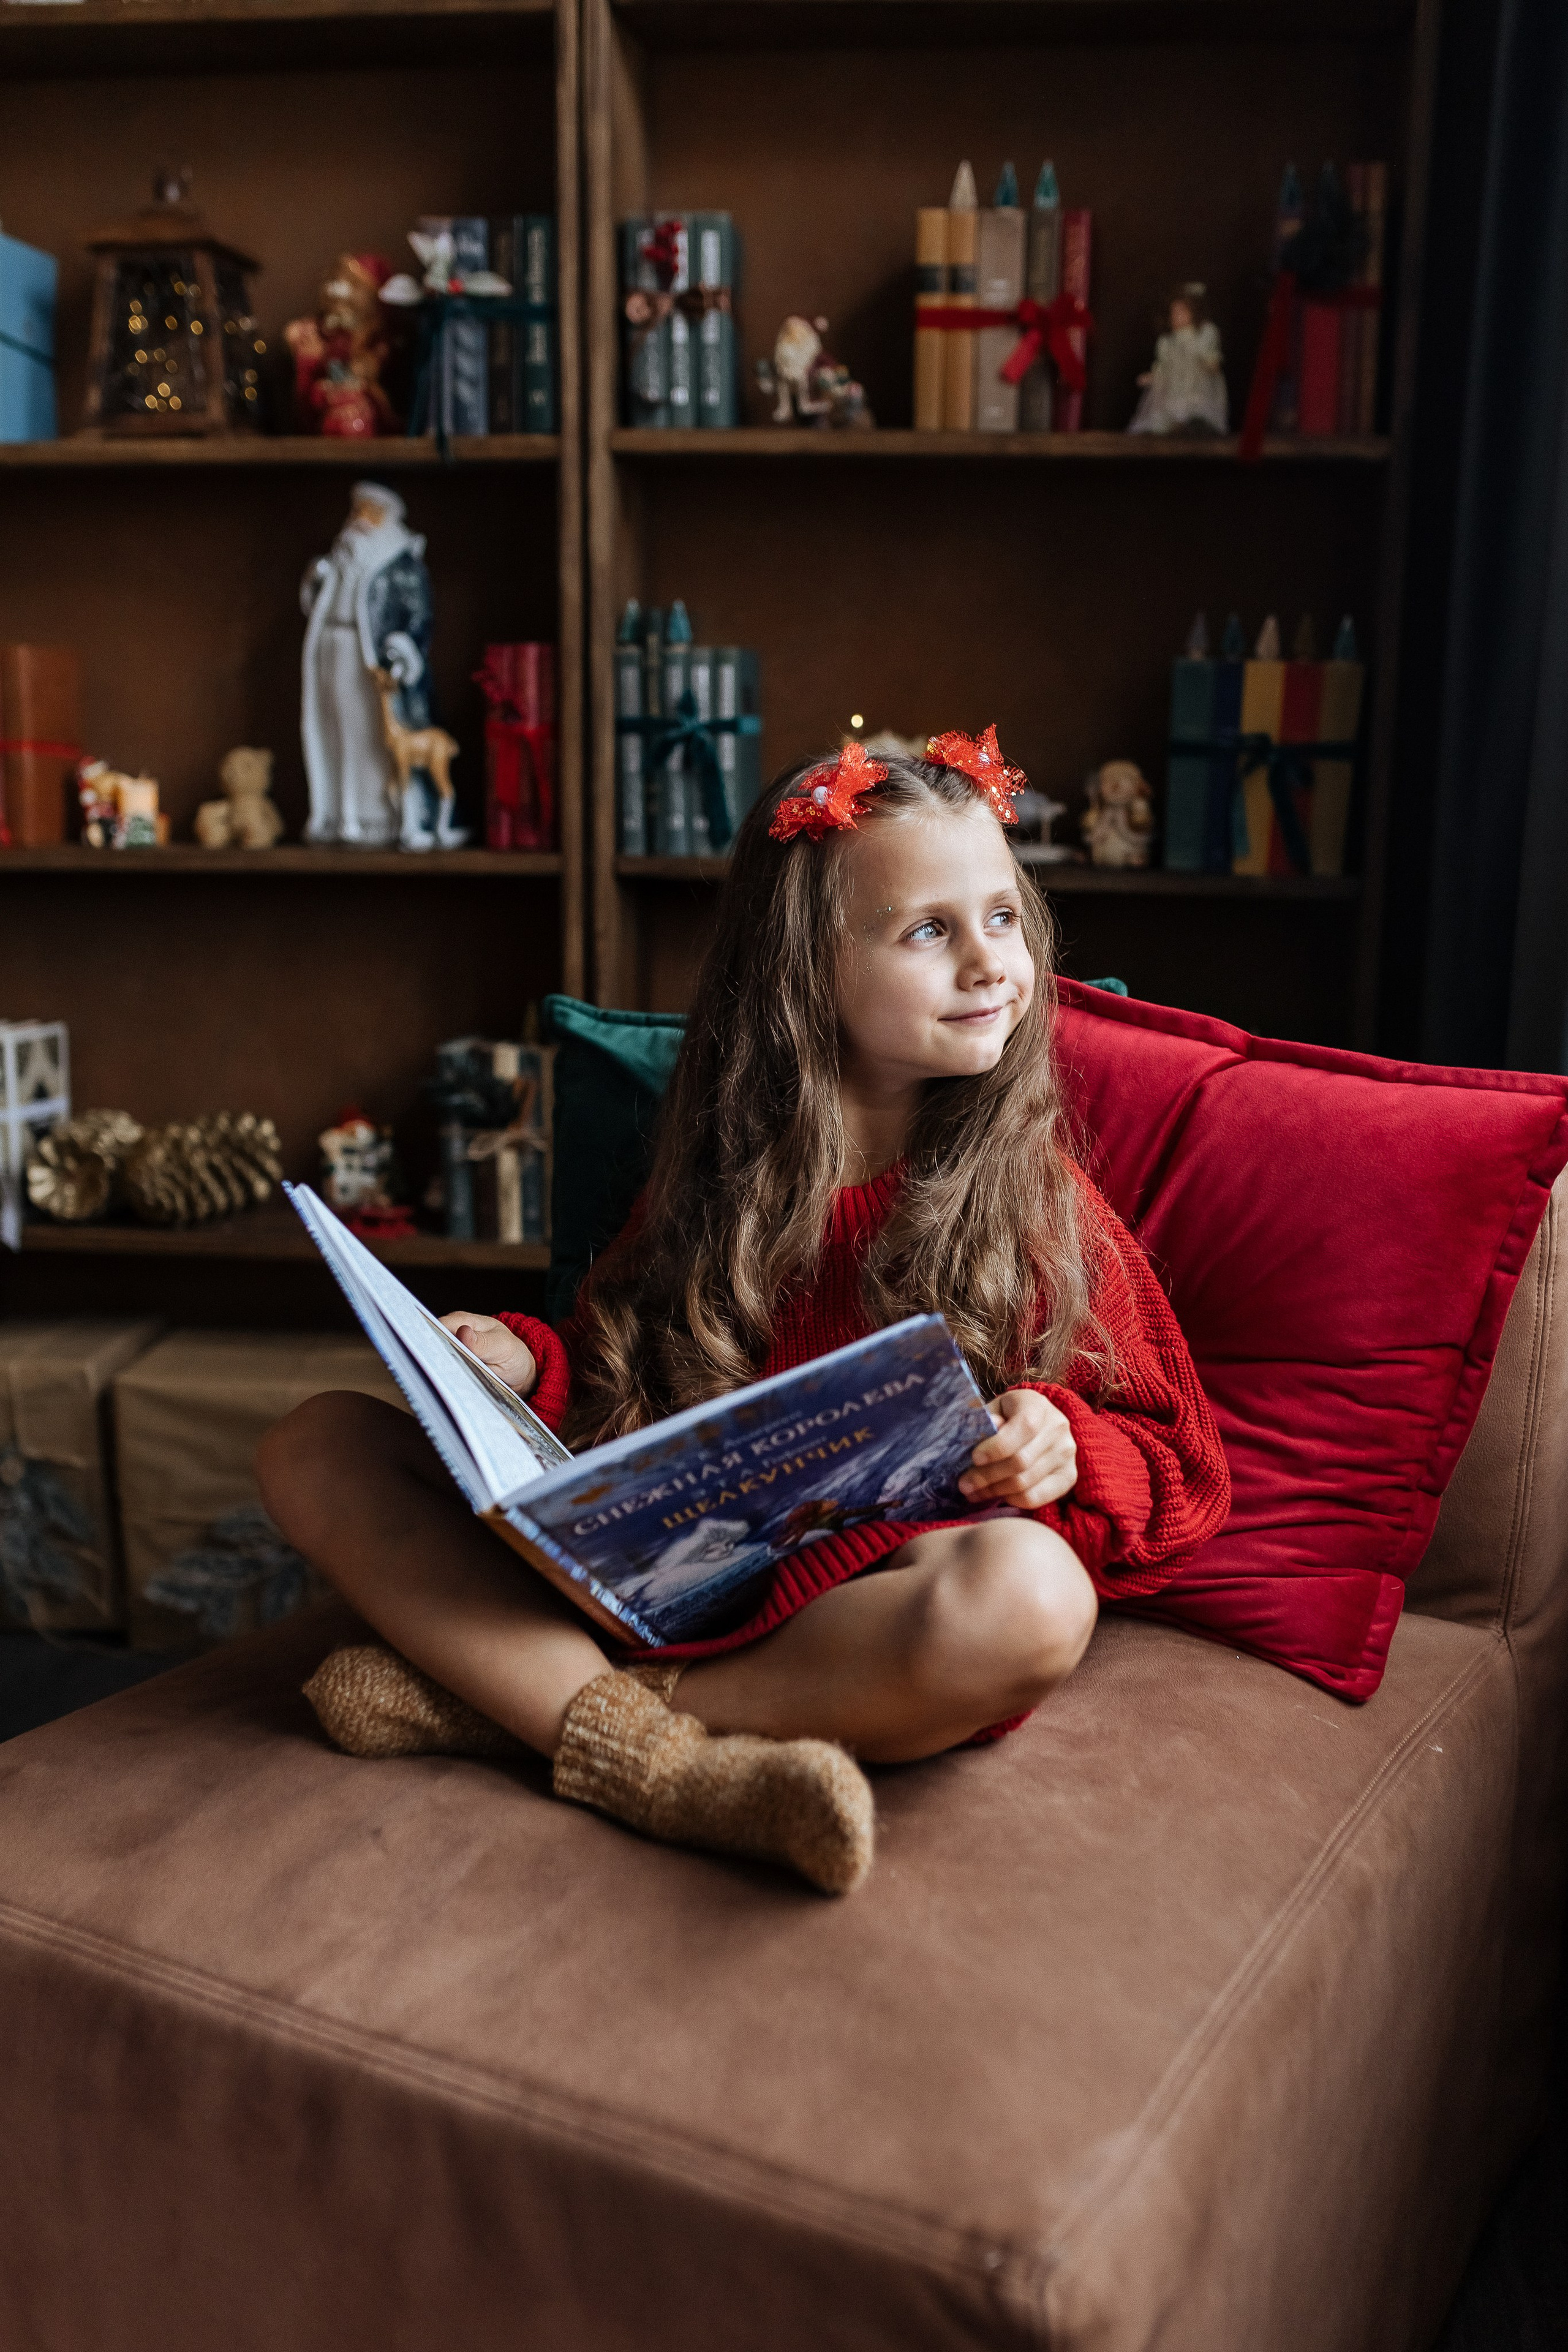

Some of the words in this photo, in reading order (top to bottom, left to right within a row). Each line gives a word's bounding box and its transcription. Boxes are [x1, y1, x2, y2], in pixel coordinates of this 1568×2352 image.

[573, 1450, 743, 1536] СНЕЖНАЯ
[750, 1373, 925, 1456] КОРОЛЕВА
[662, 1426, 875, 1529] ЩЕЛКУНЧИК
